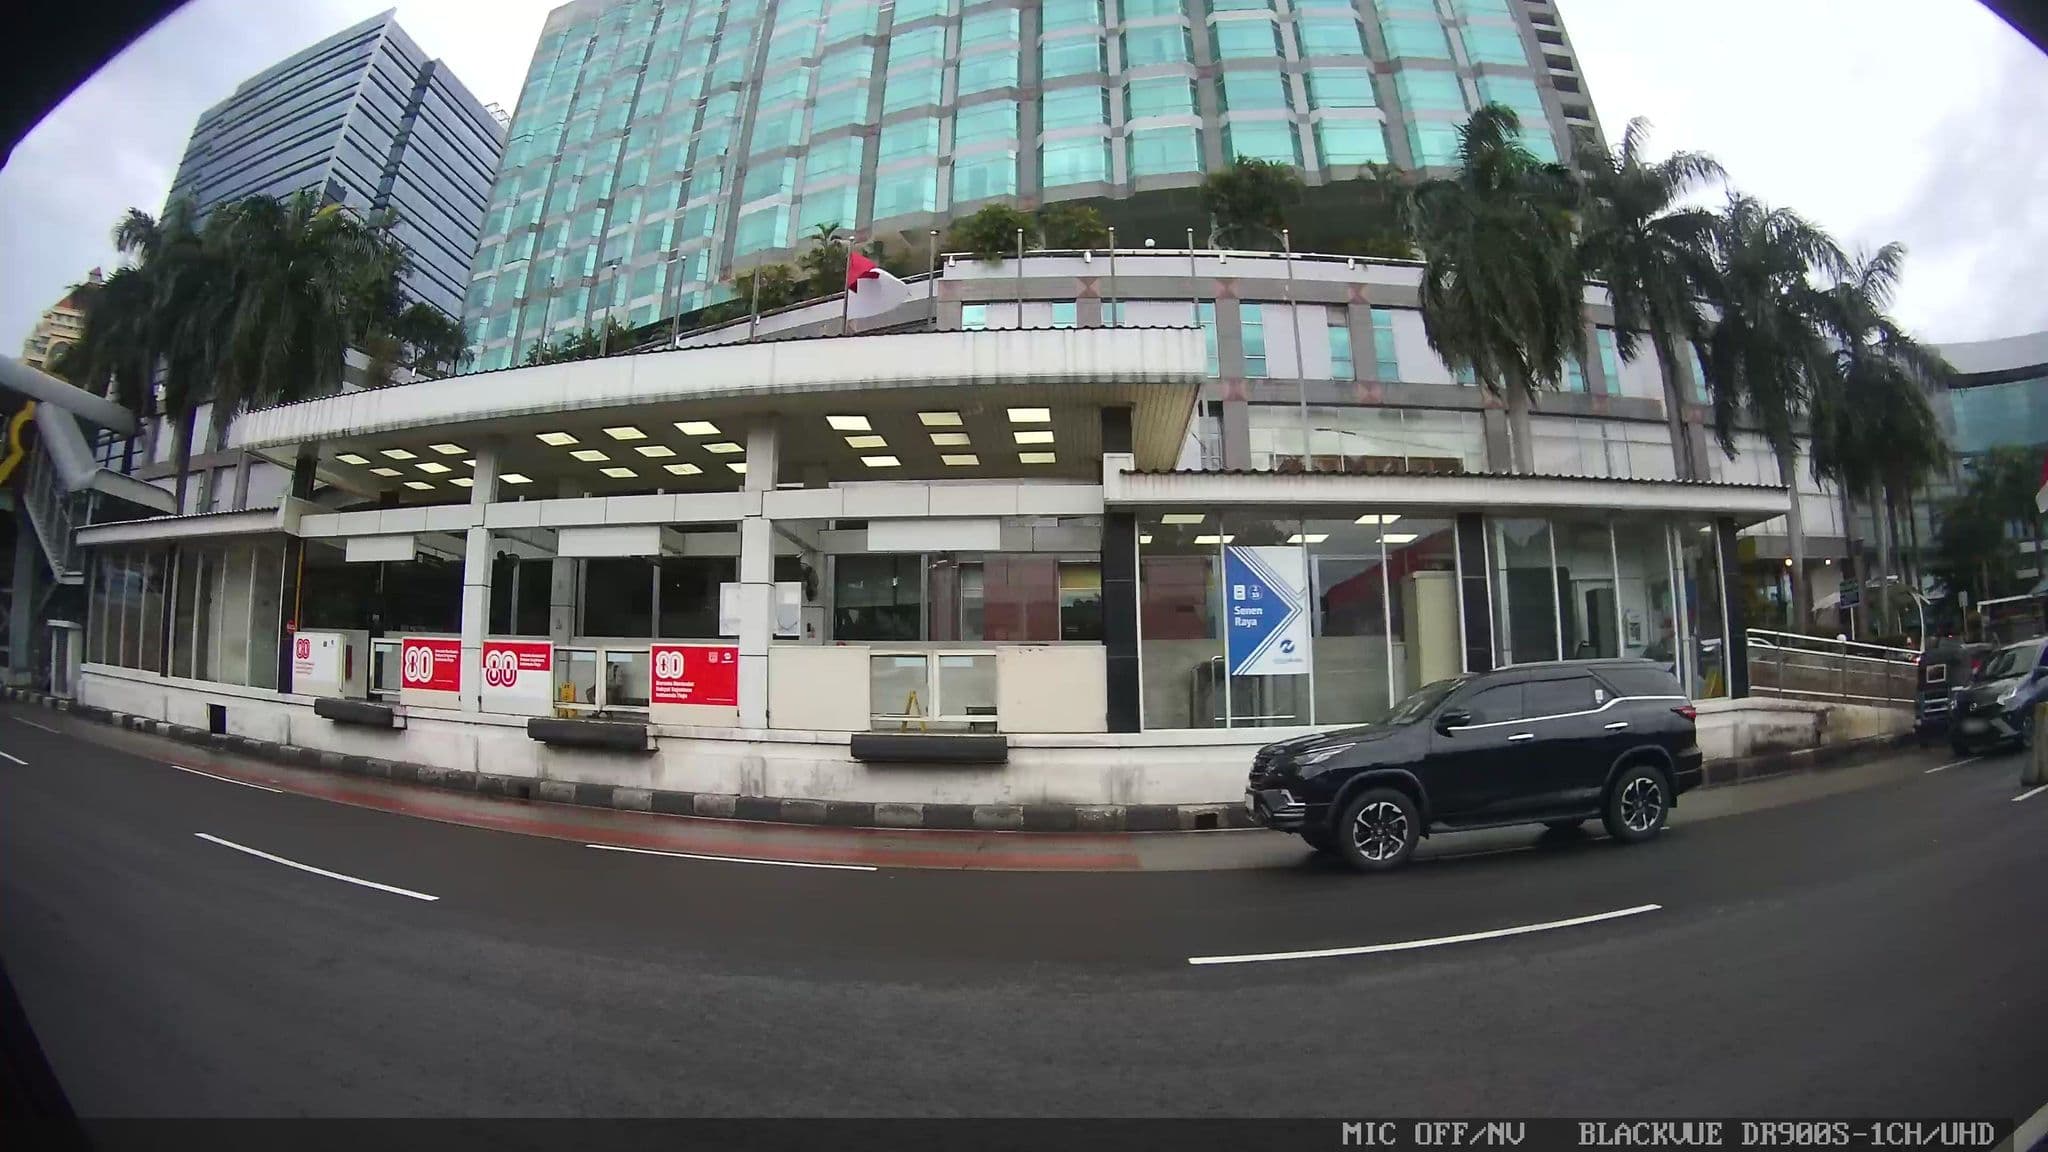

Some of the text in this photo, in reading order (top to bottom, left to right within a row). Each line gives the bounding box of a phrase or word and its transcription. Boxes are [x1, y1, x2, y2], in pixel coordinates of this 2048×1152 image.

[1234, 606, 1263, 615] Senen
[1235, 617, 1257, 628] Raya
[405, 646, 433, 683] 80
[656, 651, 684, 679] 80
